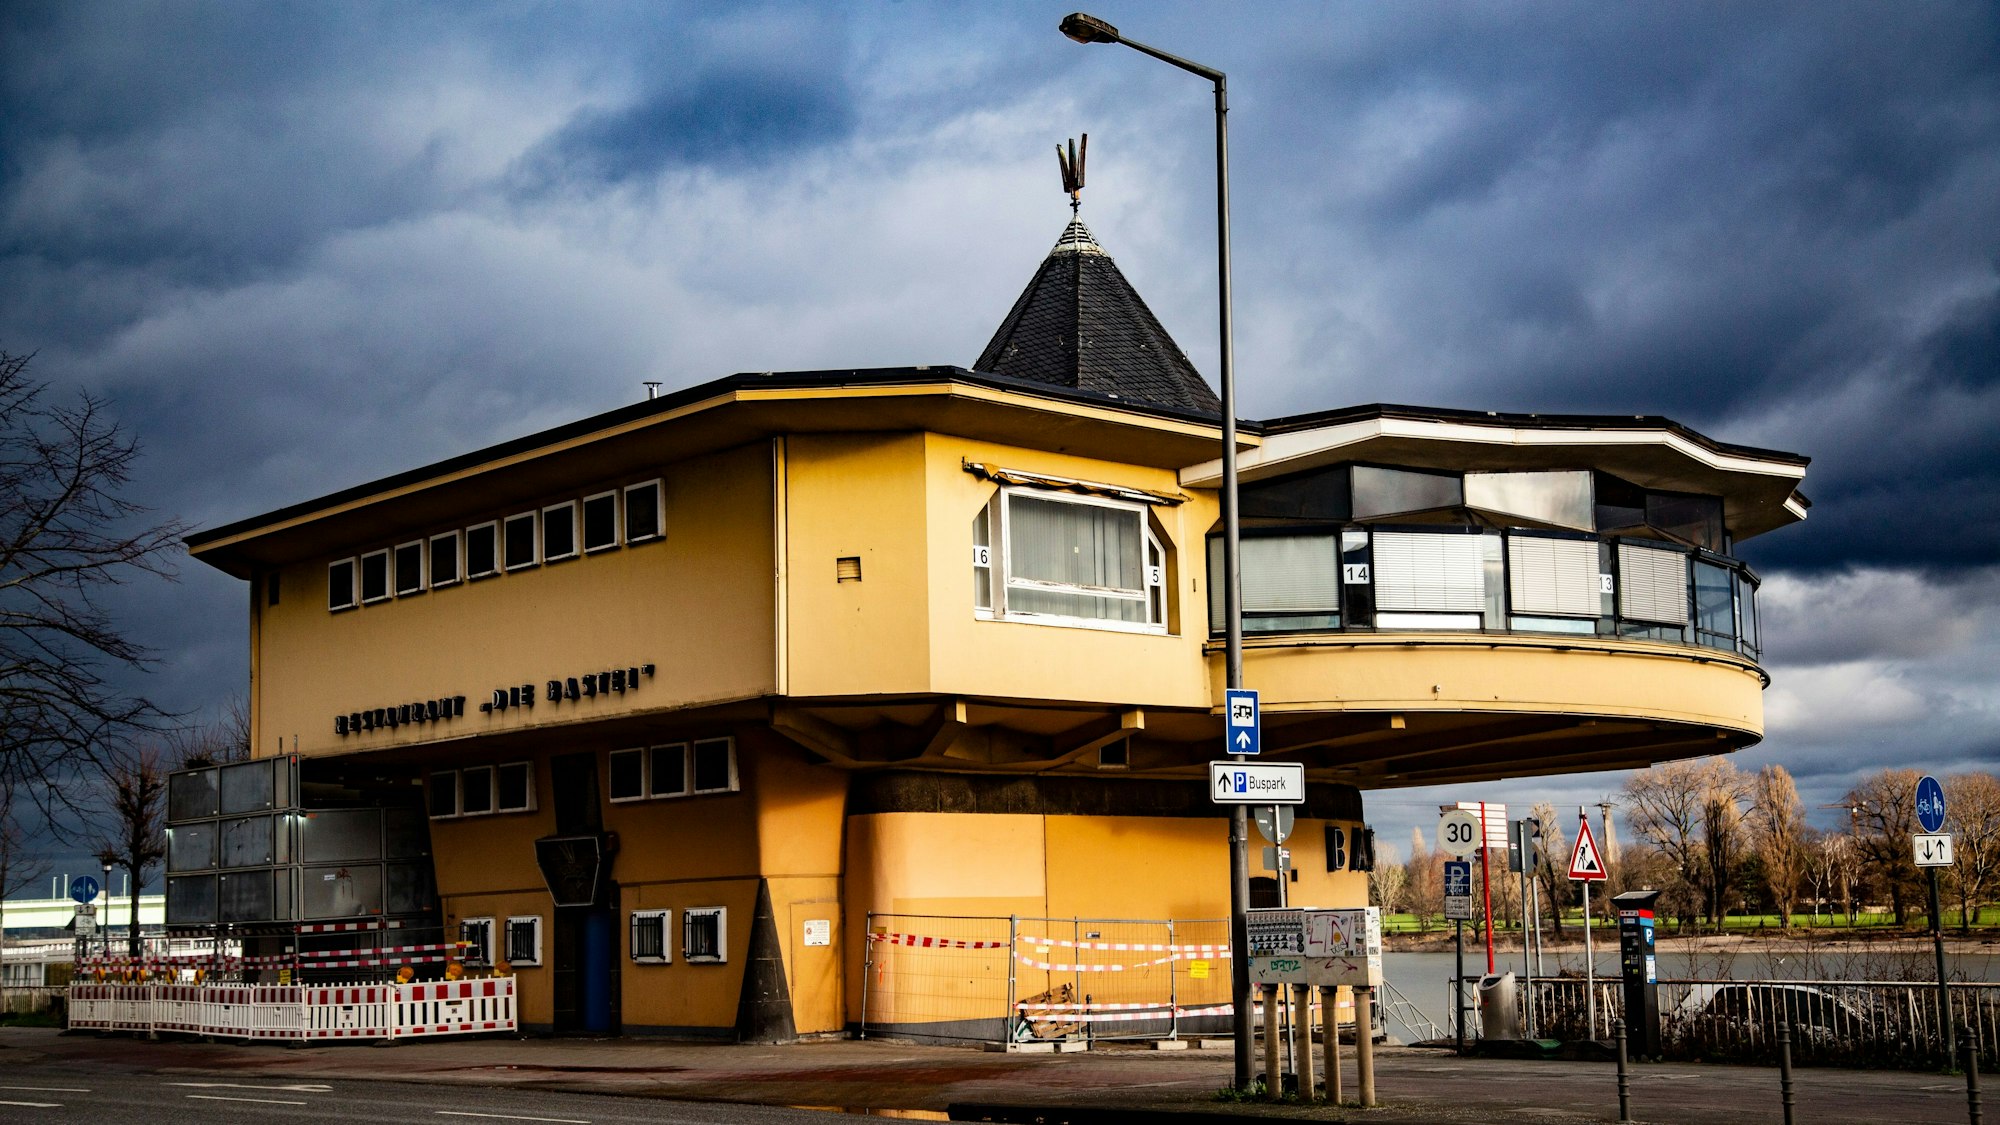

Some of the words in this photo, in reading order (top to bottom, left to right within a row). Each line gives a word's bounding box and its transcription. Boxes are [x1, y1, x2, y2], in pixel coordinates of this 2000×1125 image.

[973, 547, 988, 564] 16
[1346, 566, 1368, 581] 14
[1599, 576, 1613, 591] 13
[335, 696, 466, 736] RESTAURANT
[1249, 776, 1286, 793] Buspark
[1446, 823, 1472, 843] 30
